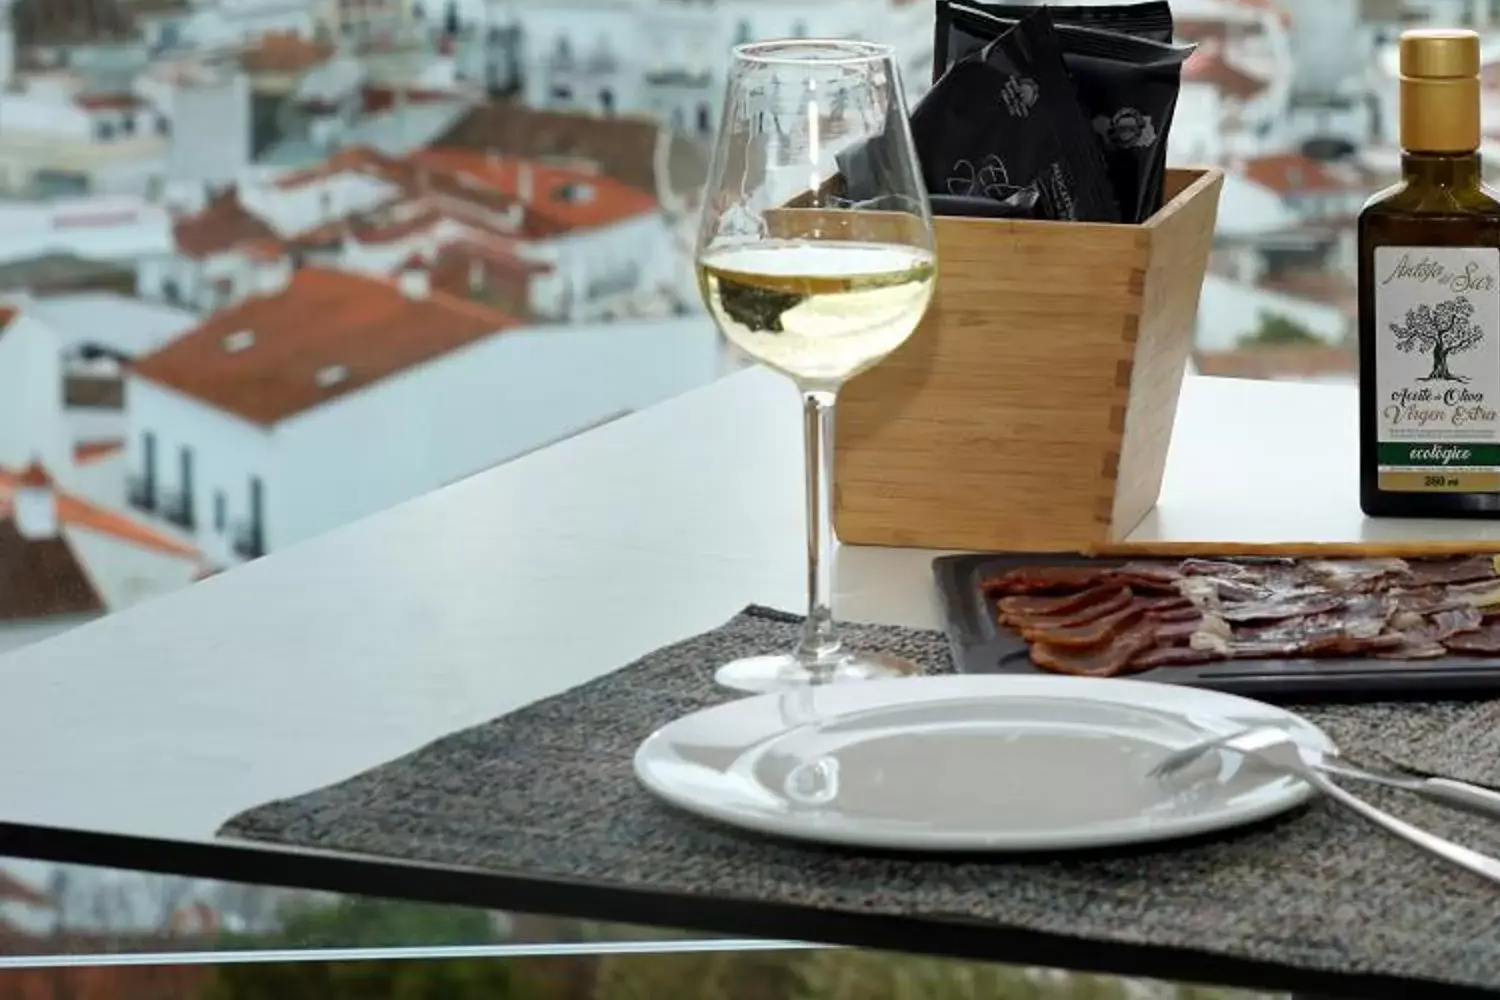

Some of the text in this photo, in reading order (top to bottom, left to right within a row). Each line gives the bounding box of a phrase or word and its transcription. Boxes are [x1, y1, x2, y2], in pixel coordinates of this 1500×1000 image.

[1443, 386, 1484, 407] Oliva
[1383, 404, 1499, 427] Virgen Extra
[1408, 444, 1473, 466] ecológico
